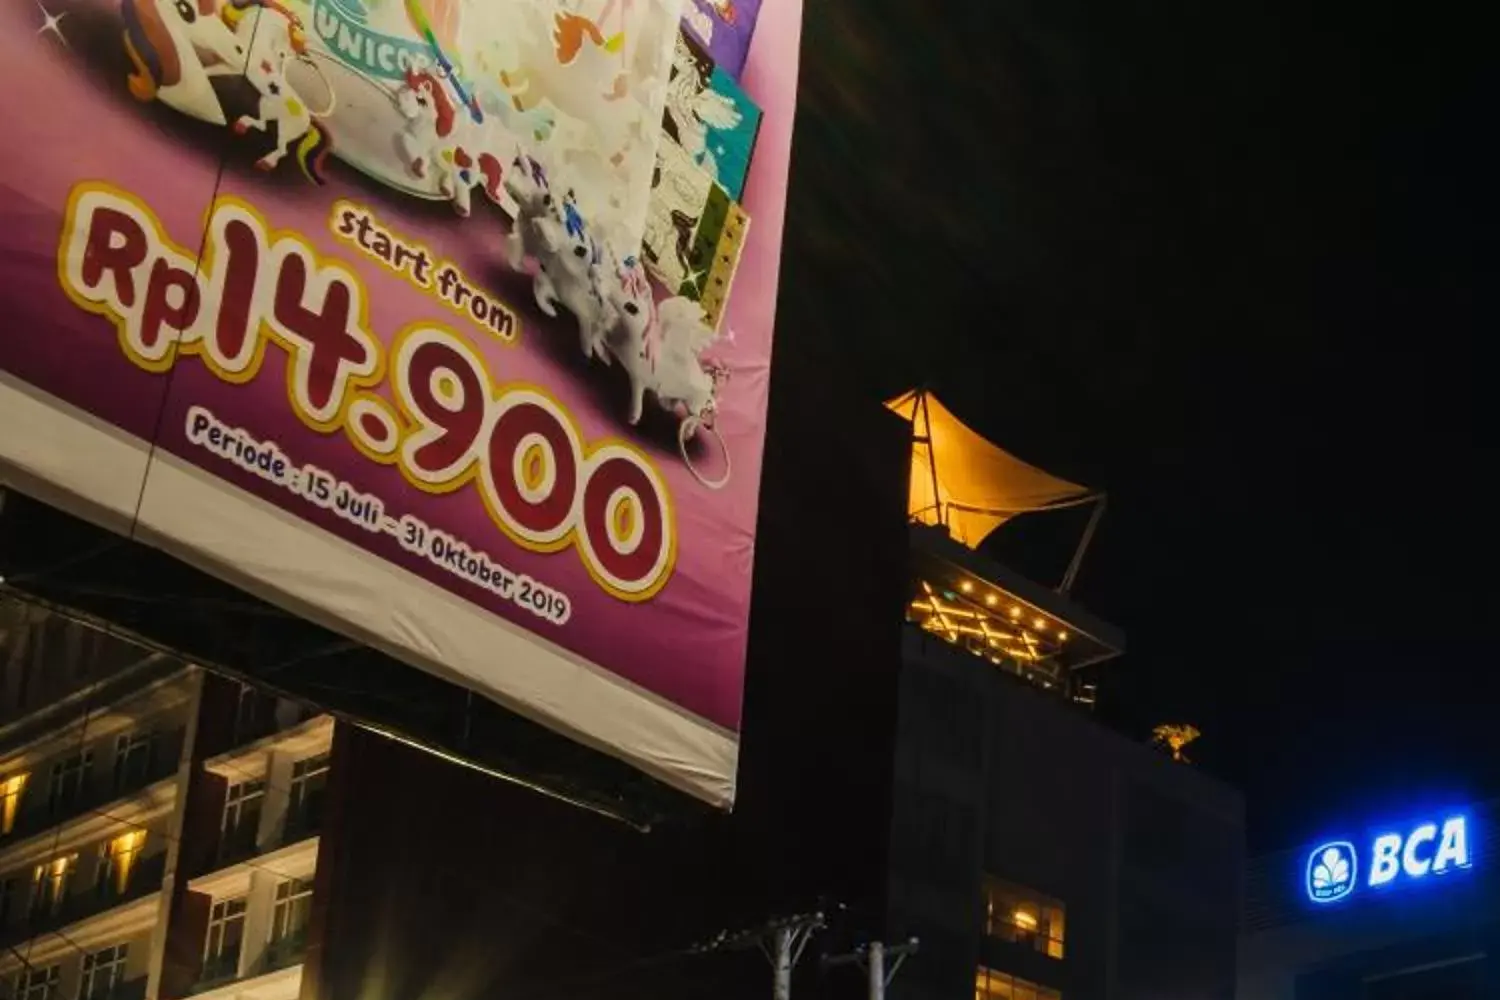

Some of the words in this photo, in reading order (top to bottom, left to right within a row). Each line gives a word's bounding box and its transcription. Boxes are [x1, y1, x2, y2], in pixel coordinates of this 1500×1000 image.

[338, 208, 429, 288] start
[436, 260, 516, 337] from
[68, 190, 672, 592] Rp14.900
[190, 412, 286, 479] Periode
[306, 471, 330, 502] 15
[335, 487, 379, 526] Juli
[402, 521, 425, 549] 31
[518, 582, 566, 620] 2019
[1367, 814, 1468, 888] BCA
